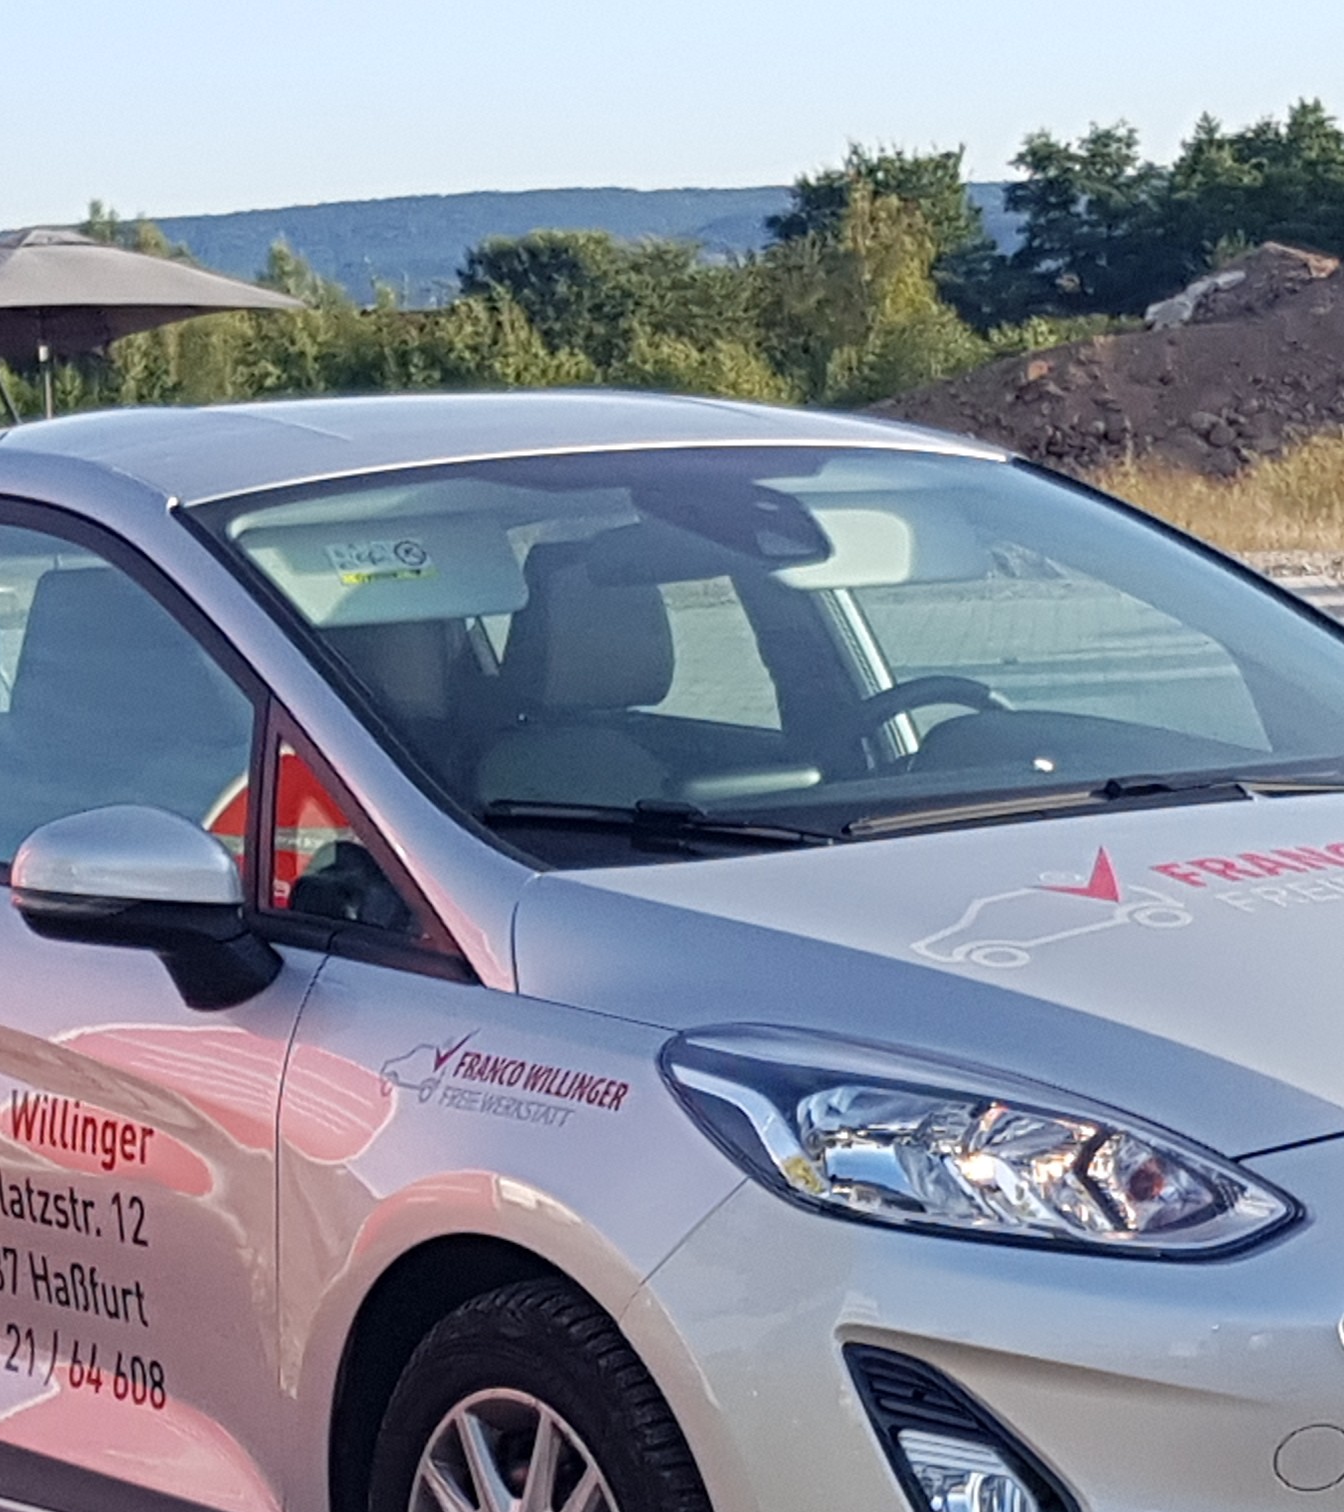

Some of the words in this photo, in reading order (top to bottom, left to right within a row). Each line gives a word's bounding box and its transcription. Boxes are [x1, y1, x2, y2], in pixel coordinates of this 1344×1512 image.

[452, 1051, 527, 1088] FRANCO
[522, 1063, 630, 1112] WILLINGER
[478, 1093, 577, 1128] WERKSTATT
[10, 1089, 155, 1172] Willinger
[111, 1191, 149, 1247] 12
[28, 1251, 149, 1328] Haßfurt
[5, 1323, 36, 1377] 21
[43, 1329, 58, 1387] /
[68, 1340, 103, 1393] 64
[112, 1351, 167, 1410] 608
